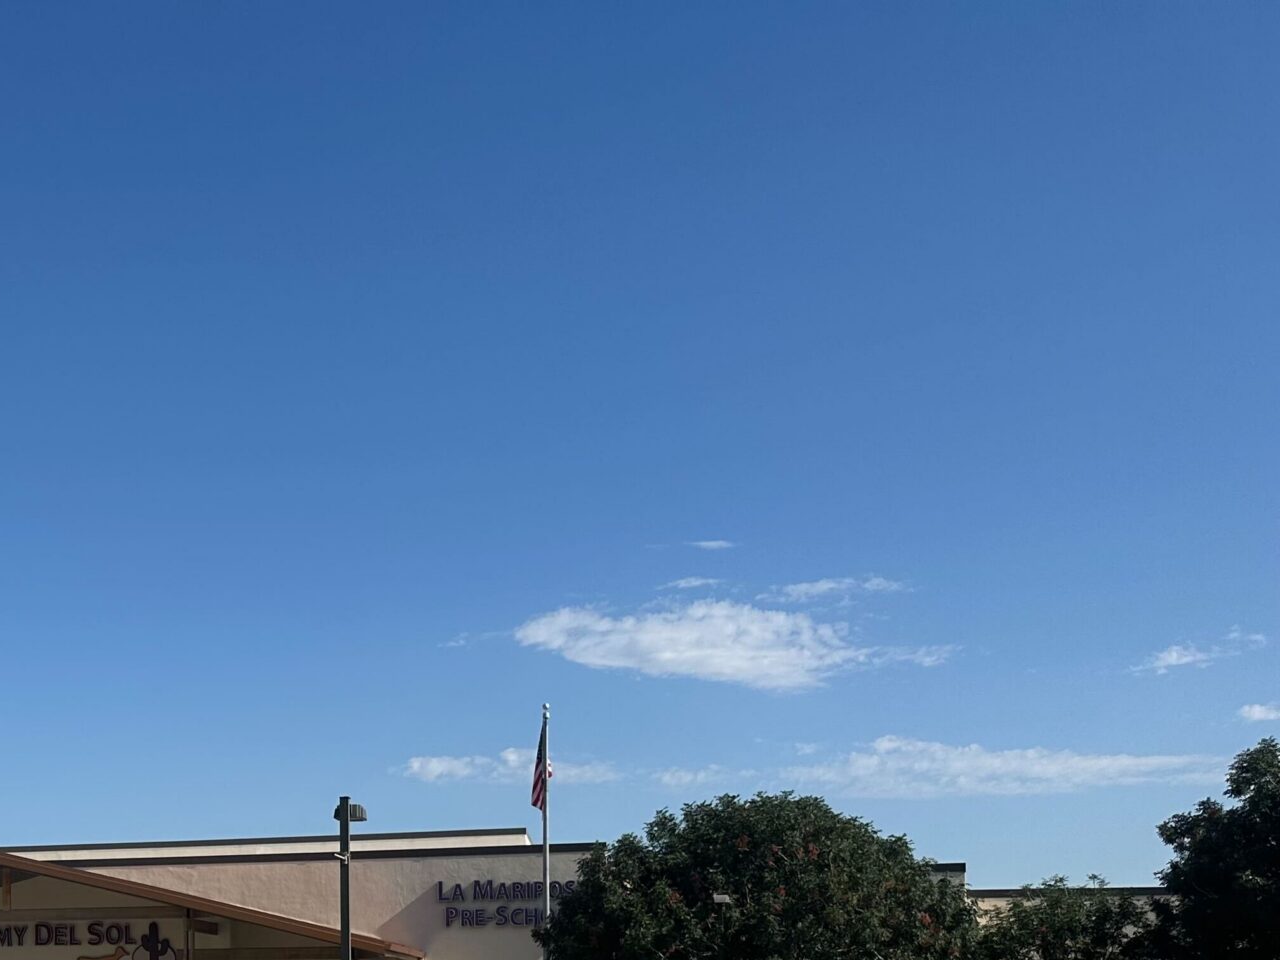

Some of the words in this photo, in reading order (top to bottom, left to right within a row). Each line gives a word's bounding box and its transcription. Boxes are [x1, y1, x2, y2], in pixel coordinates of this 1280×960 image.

[437, 880, 465, 901] LA
[34, 921, 81, 946] DEL
[87, 920, 136, 946] SOL
